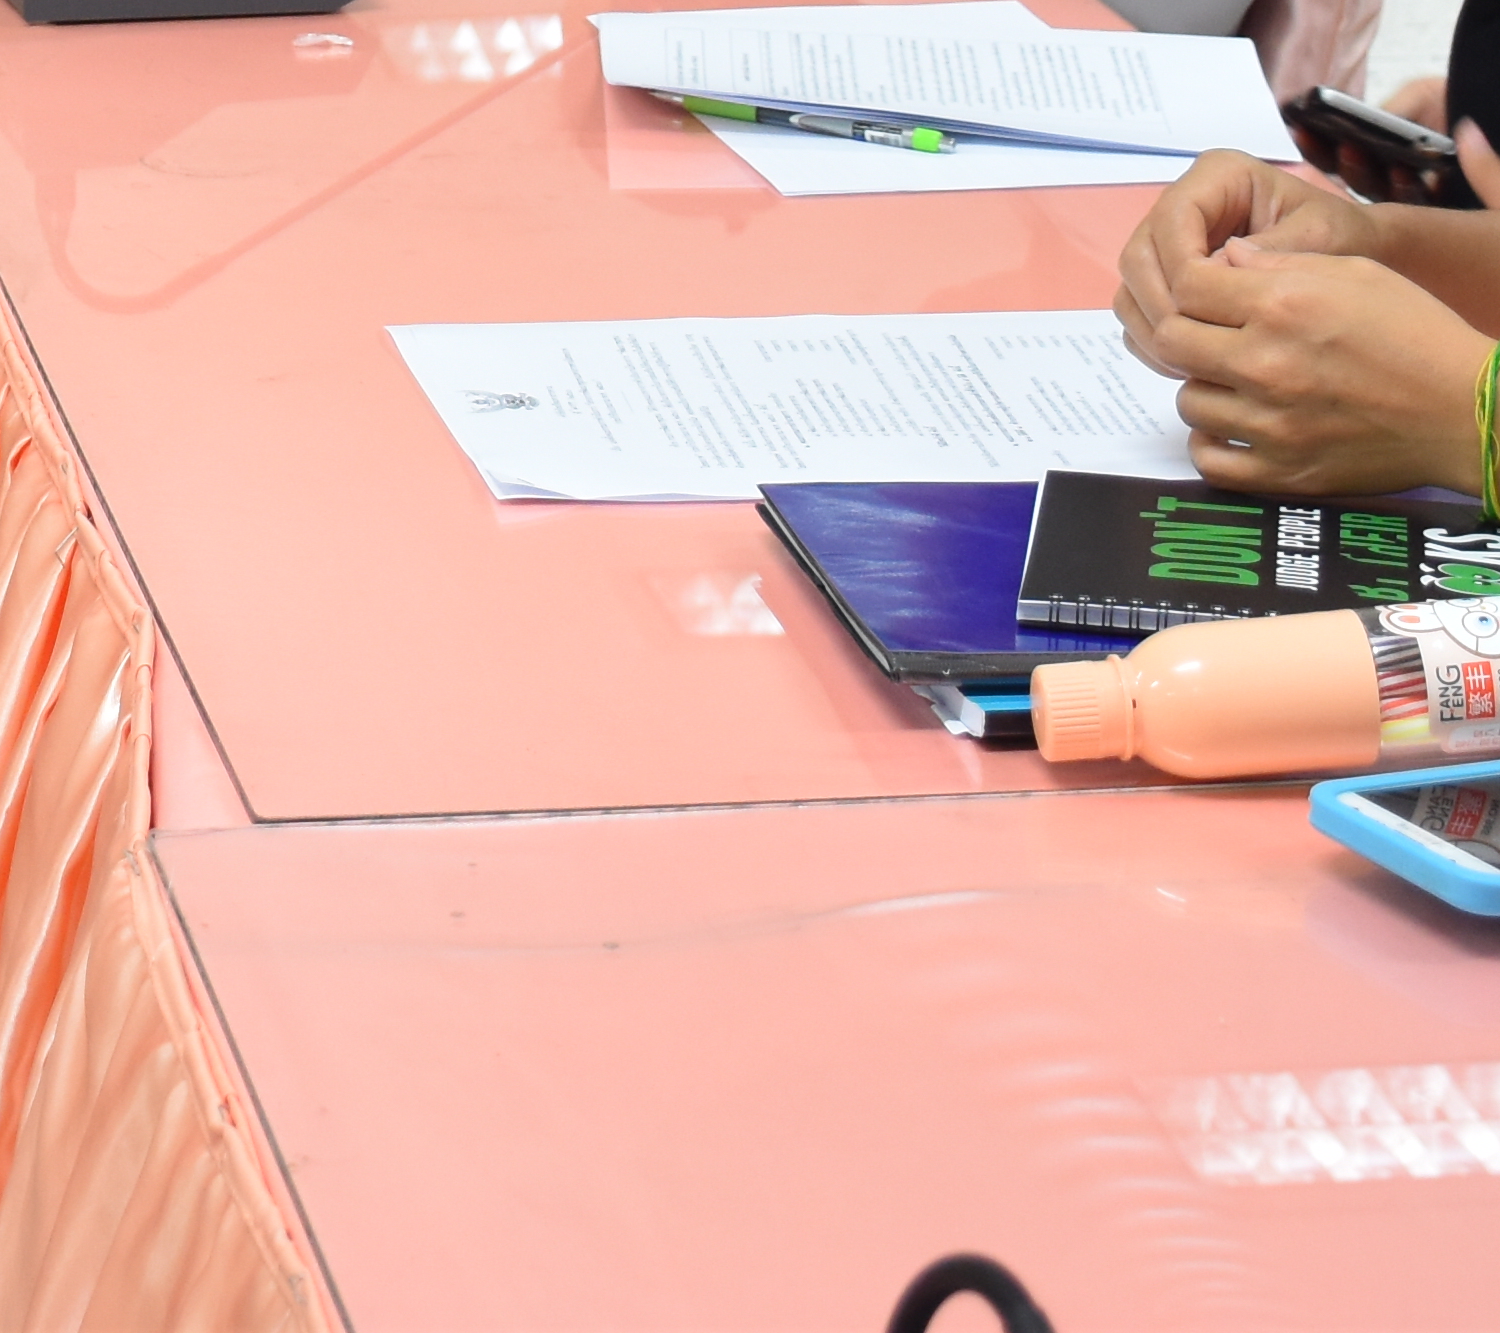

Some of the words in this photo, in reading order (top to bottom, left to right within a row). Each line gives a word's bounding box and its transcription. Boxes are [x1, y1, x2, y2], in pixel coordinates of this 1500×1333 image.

[1139, 496, 1264, 586] DON'T
[1277, 505, 1321, 551] PEOPLE
[1275, 551, 1320, 591] JUDGE
[1466, 664, 1492, 716] 繁丰
